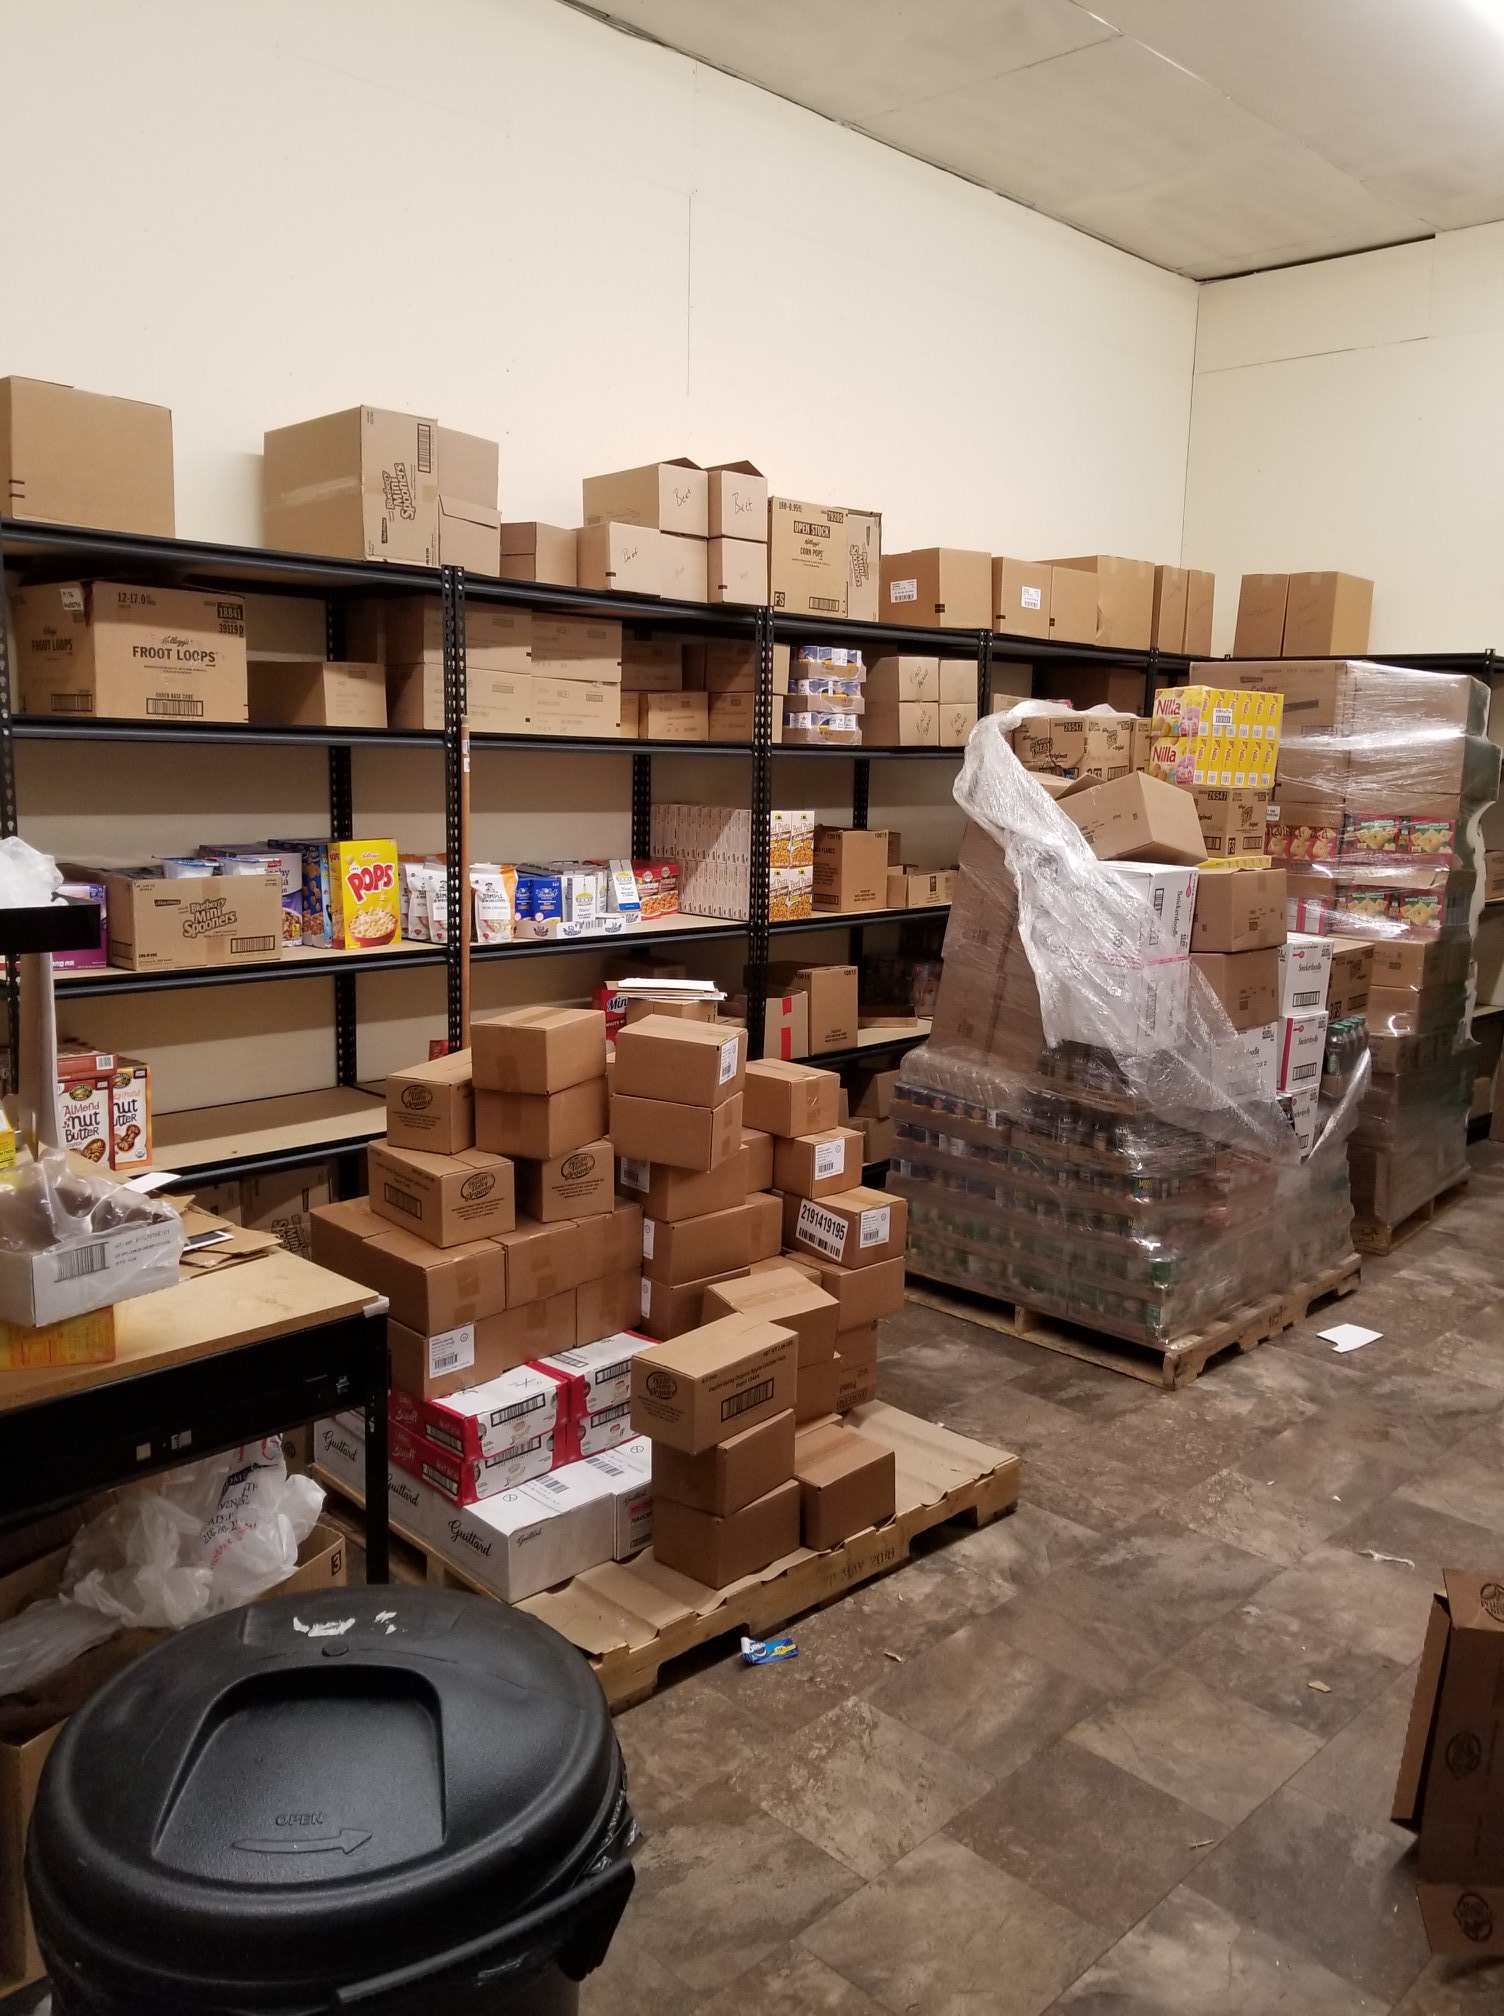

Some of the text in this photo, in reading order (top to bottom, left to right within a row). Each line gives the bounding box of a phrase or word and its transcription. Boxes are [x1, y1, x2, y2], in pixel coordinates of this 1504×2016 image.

[794, 522, 830, 538] OPEN STOCK
[775, 592, 785, 606] FS
[132, 646, 216, 663] FROOT LOOPS
[1156, 699, 1181, 716] Nilla
[1152, 746, 1176, 762] Nilla
[346, 862, 395, 904] POPS
[190, 898, 226, 914] Blueberry
[194, 908, 223, 924] Mini
[183, 911, 237, 939] Spooners
[607, 996, 627, 1011] Min
[801, 1204, 845, 1240] 2191419195
[448, 1519, 492, 1557] Guittard
[275, 1812, 324, 1826] OPEN
